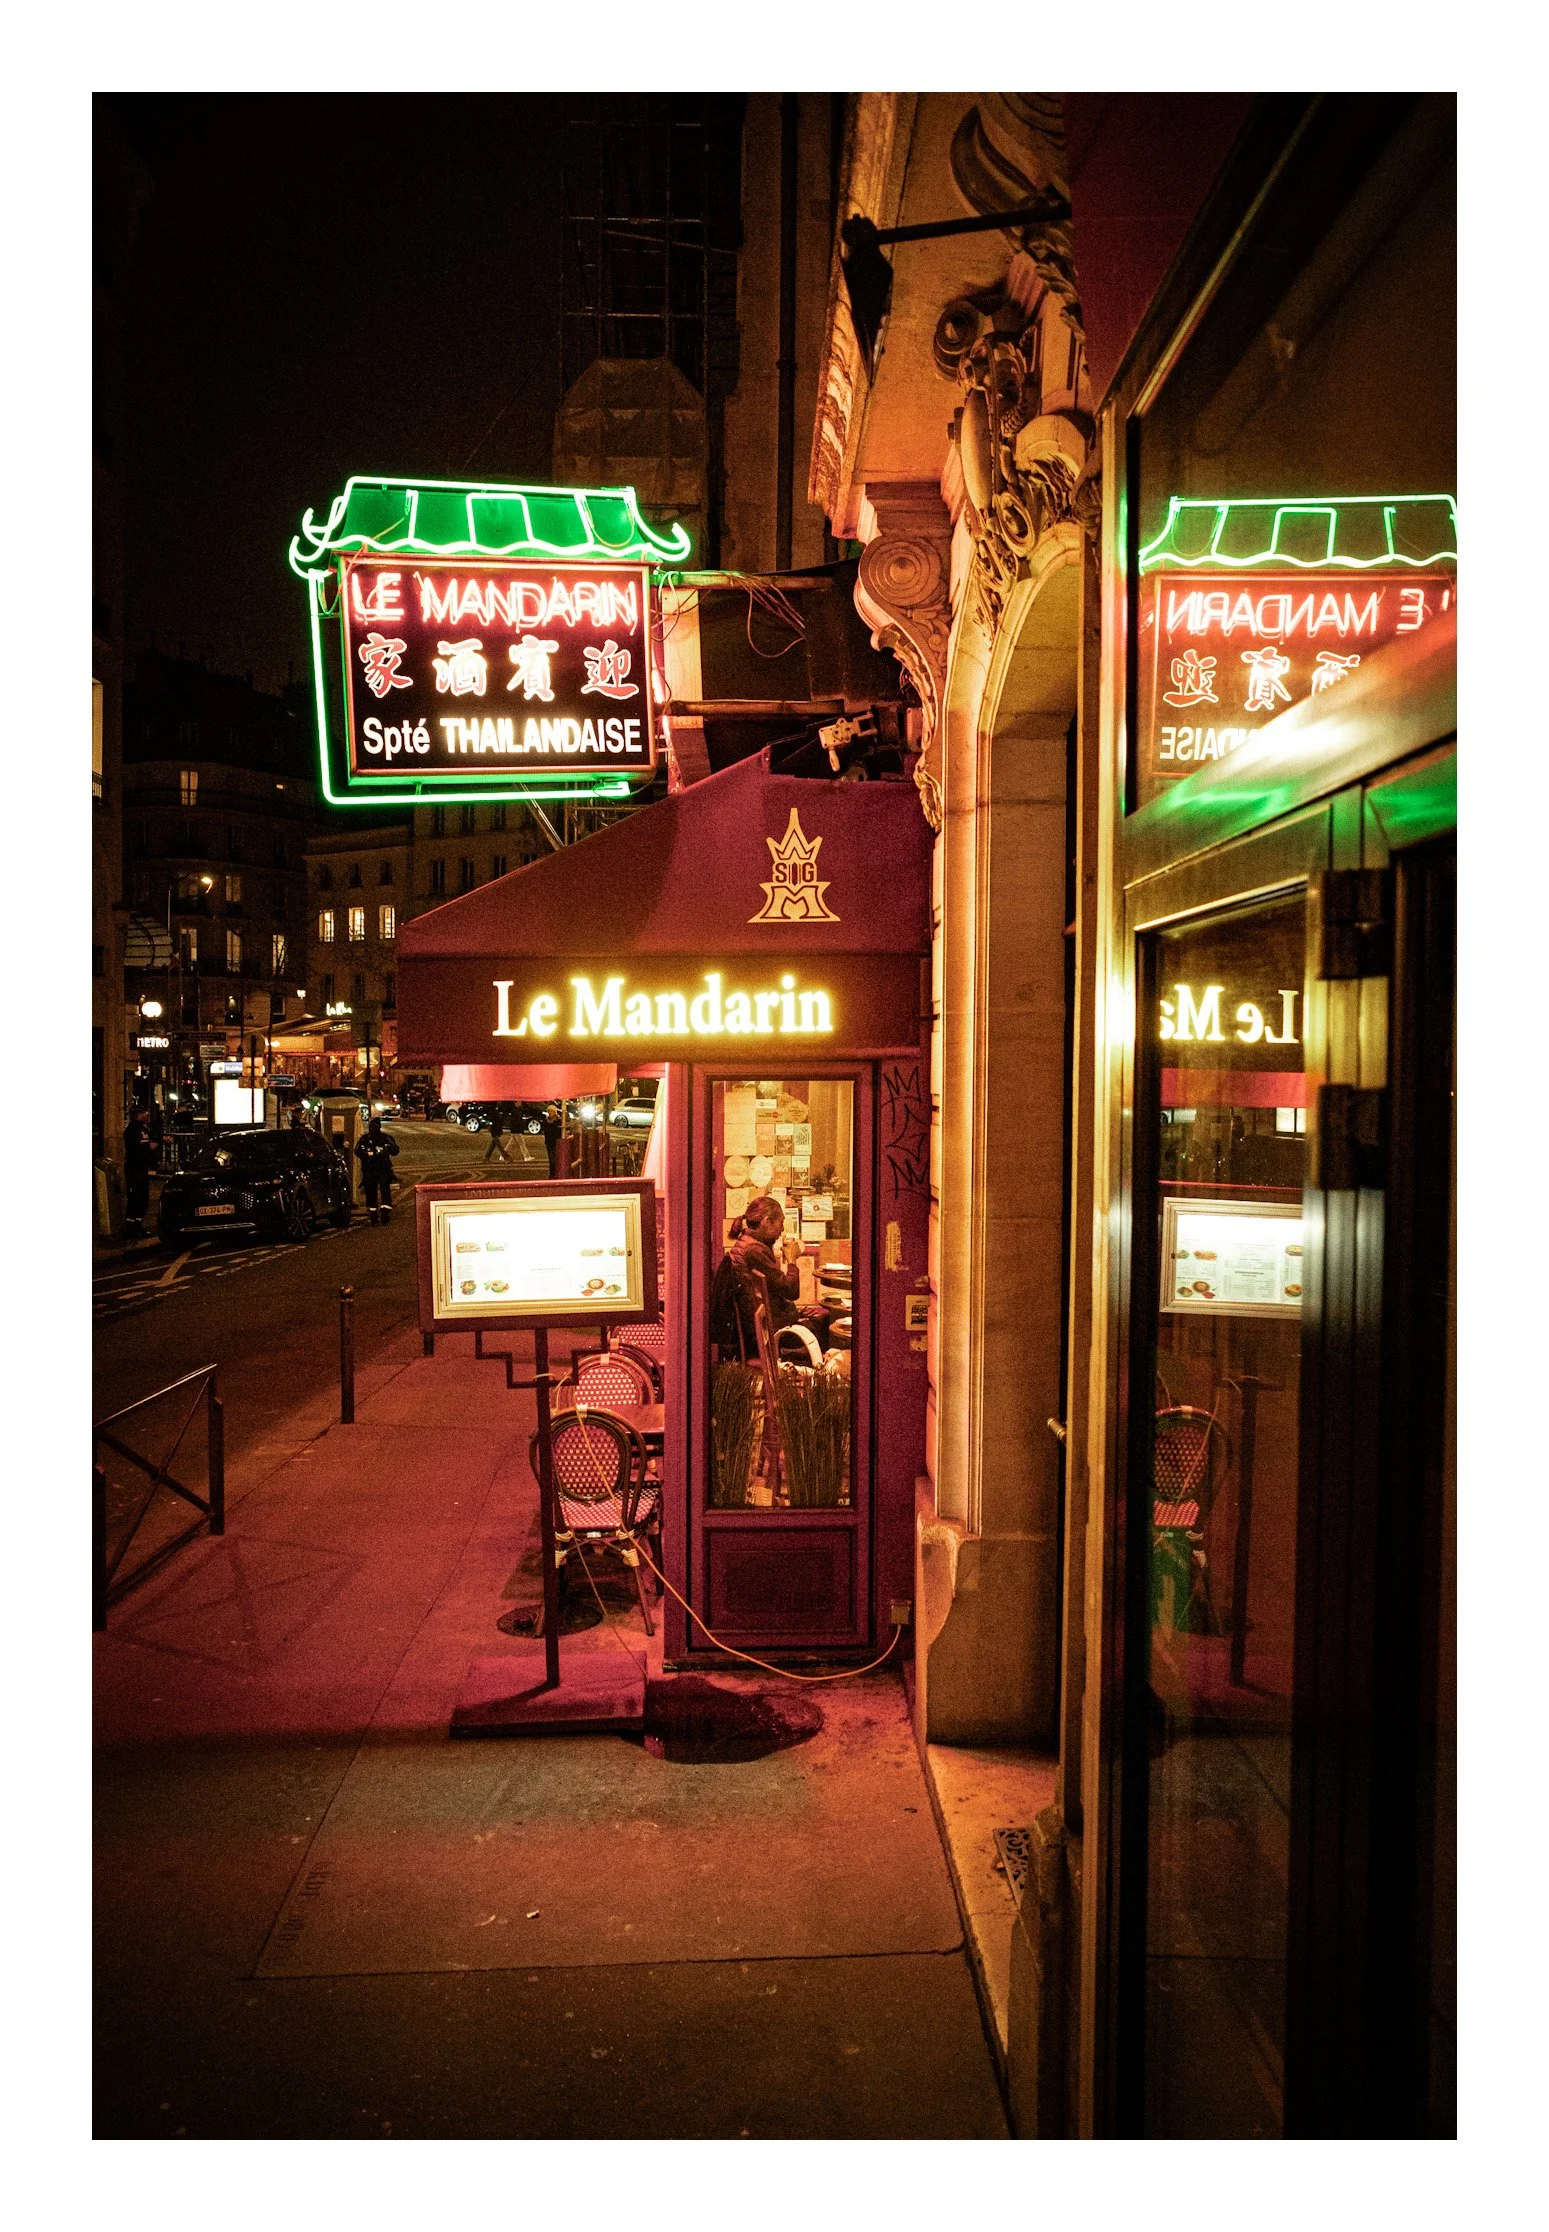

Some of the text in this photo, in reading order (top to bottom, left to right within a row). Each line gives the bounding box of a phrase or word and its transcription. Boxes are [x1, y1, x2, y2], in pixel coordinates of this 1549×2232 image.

[350, 571, 639, 632] LE MANDARIN
[363, 717, 643, 760] Spté THAILANDAISE
[492, 973, 834, 1037] Le Mandarin
